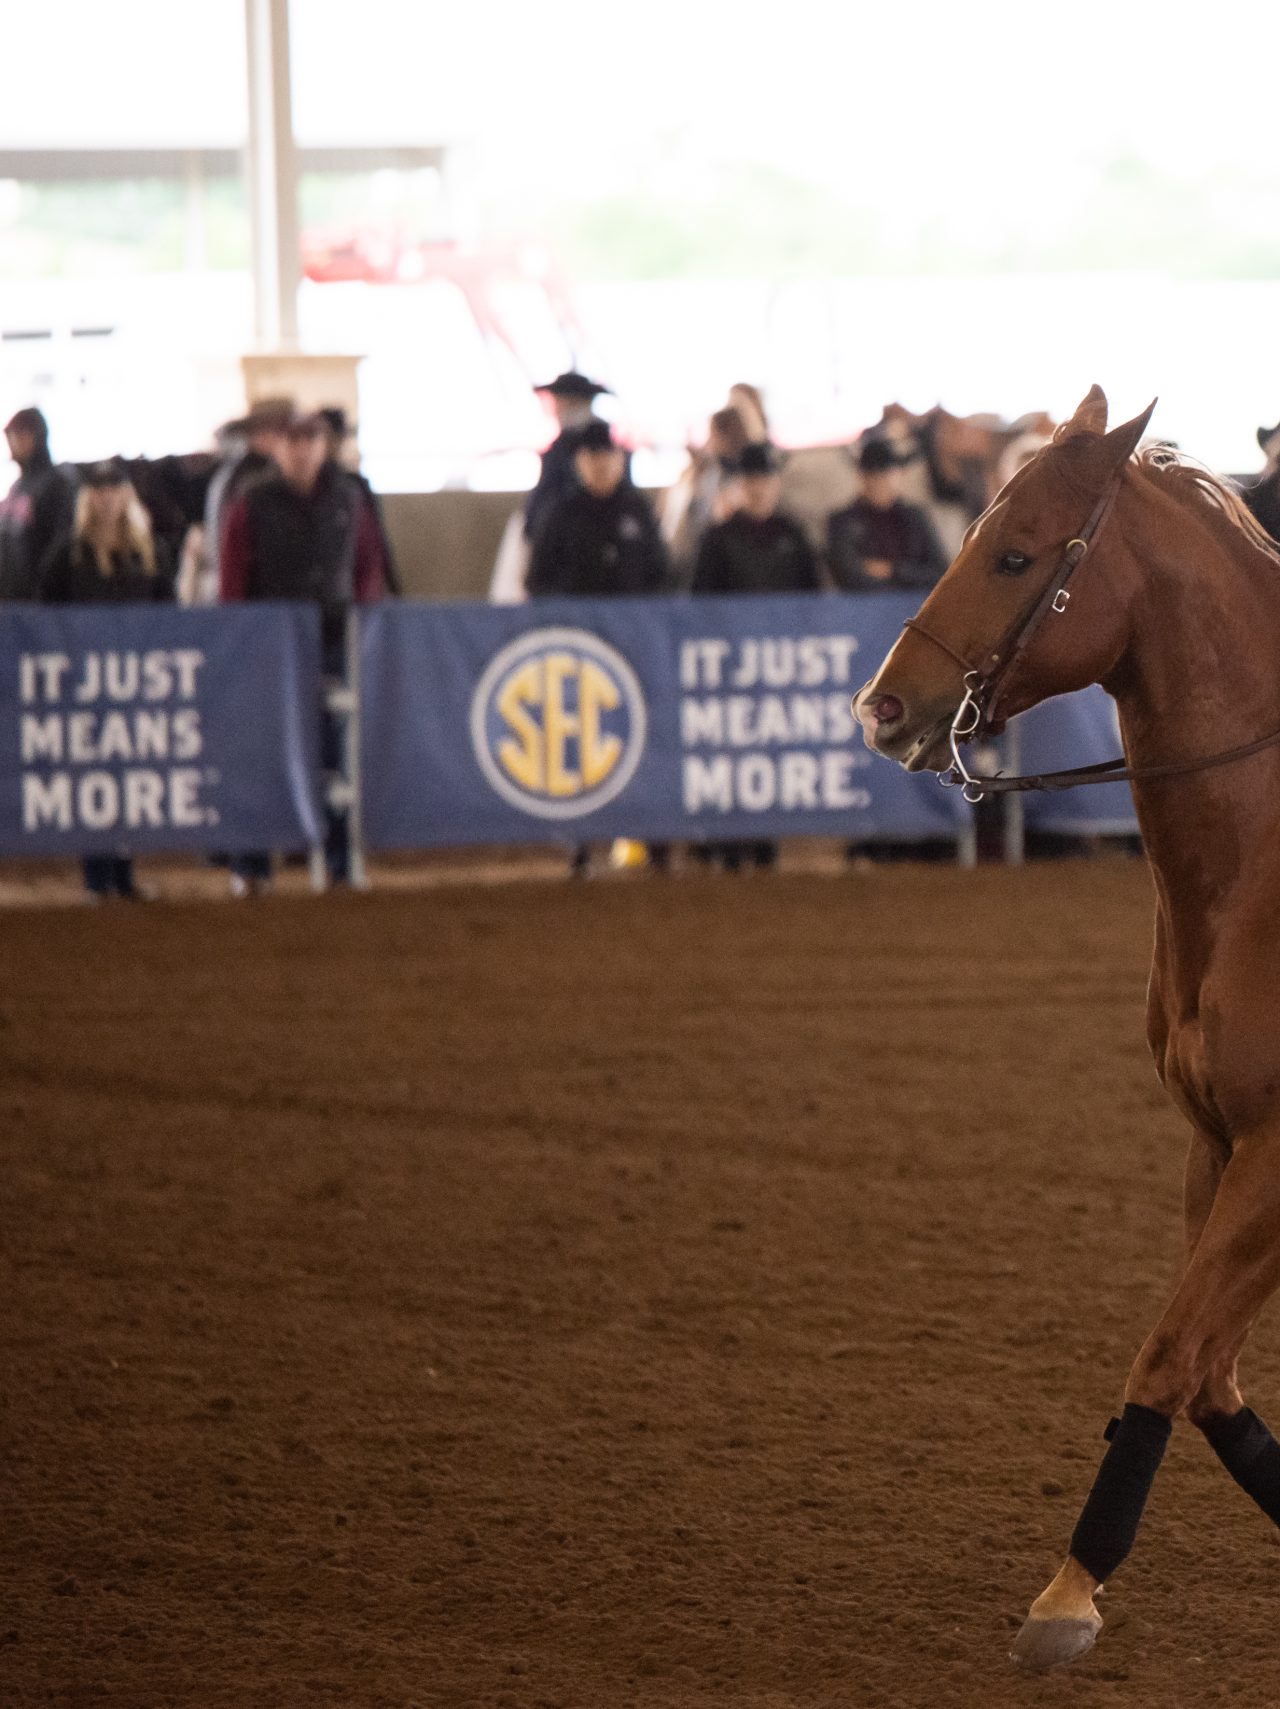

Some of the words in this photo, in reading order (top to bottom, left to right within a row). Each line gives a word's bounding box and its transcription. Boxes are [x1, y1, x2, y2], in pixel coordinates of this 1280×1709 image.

[19, 653, 69, 699] IT
[75, 648, 203, 700] JUST
[679, 638, 730, 689] IT
[733, 635, 857, 687] JUST
[21, 709, 202, 762] MEANS
[497, 652, 622, 797] SEC
[680, 693, 857, 746] MEANS
